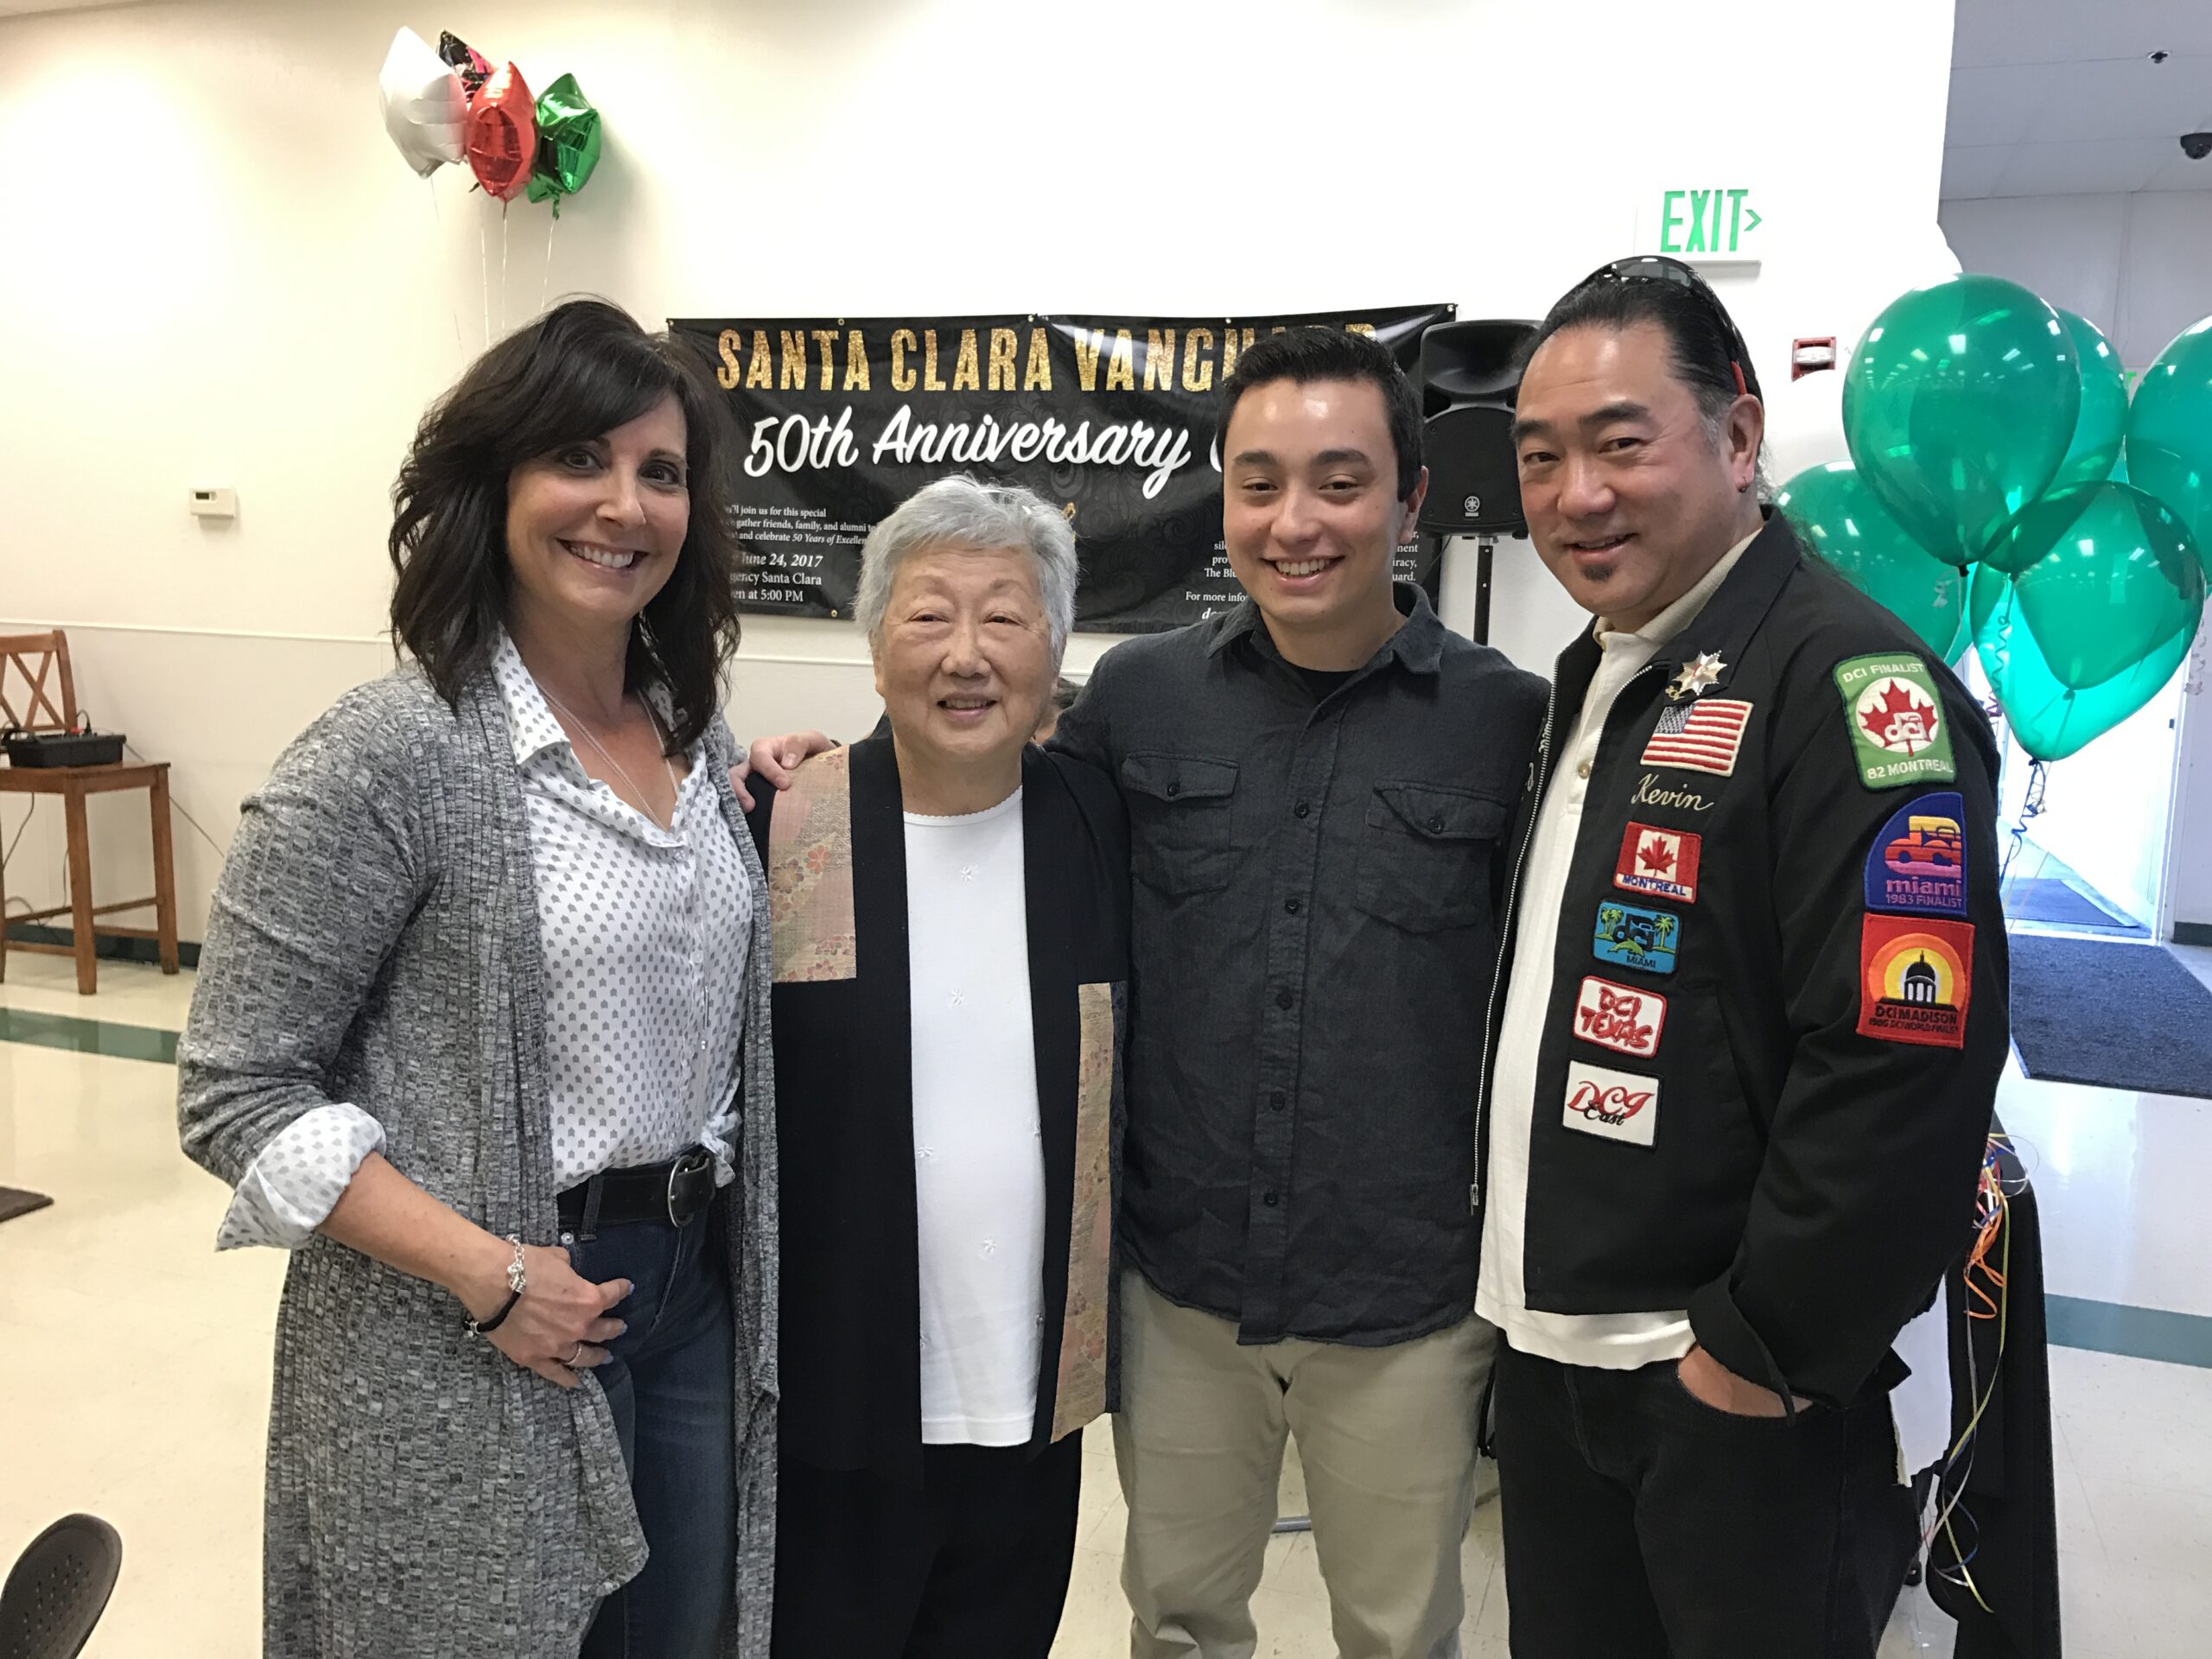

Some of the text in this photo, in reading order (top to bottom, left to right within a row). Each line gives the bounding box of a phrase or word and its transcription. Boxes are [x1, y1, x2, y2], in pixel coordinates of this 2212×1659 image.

[1660, 188, 1749, 253] EXIT
[716, 328, 871, 391] SANTA
[890, 327, 1053, 392] CLARA
[743, 404, 860, 478] 50th
[871, 404, 1192, 499] Anniversary
[740, 505, 757, 517] join
[759, 507, 768, 516] us
[769, 505, 782, 516] for
[783, 506, 799, 517] this
[799, 507, 827, 519] special
[735, 518, 761, 530] gather
[762, 518, 794, 530] friends,
[795, 519, 823, 533] family,
[823, 521, 838, 531] and
[839, 521, 867, 532] alumni
[739, 530, 753, 540] and
[754, 531, 791, 542] celebrate
[791, 533, 804, 543] 50
[804, 533, 825, 543] Years
[826, 534, 836, 546] of
[1396, 544, 1419, 553] nent
[741, 552, 767, 566] June
[768, 553, 787, 568] 24,
[790, 554, 824, 568] 2017
[1211, 556, 1417, 569] pro iracy,
[761, 570, 791, 584] Santa
[791, 572, 823, 586] Clara
[1204, 568, 1222, 578] The
[1392, 571, 1416, 582] uard.
[747, 589, 759, 601] at
[760, 588, 783, 601] 5:00
[785, 589, 804, 602] PM
[1185, 591, 1248, 602] For more info
[1841, 663, 1924, 683] DCI FINALIST
[1866, 759, 1955, 779] 82 MONTREAL
[1630, 772, 1715, 811] Kevin
[1622, 874, 1687, 897] MONTREAL
[1885, 876, 1962, 897] miami
[1885, 893, 1963, 908] 1983 FINALIST
[1625, 955, 1656, 969] MIAMI
[1599, 986, 1642, 1020] DCI
[1580, 1005, 1653, 1049] TEXAS
[1583, 1099, 1625, 1126] East
